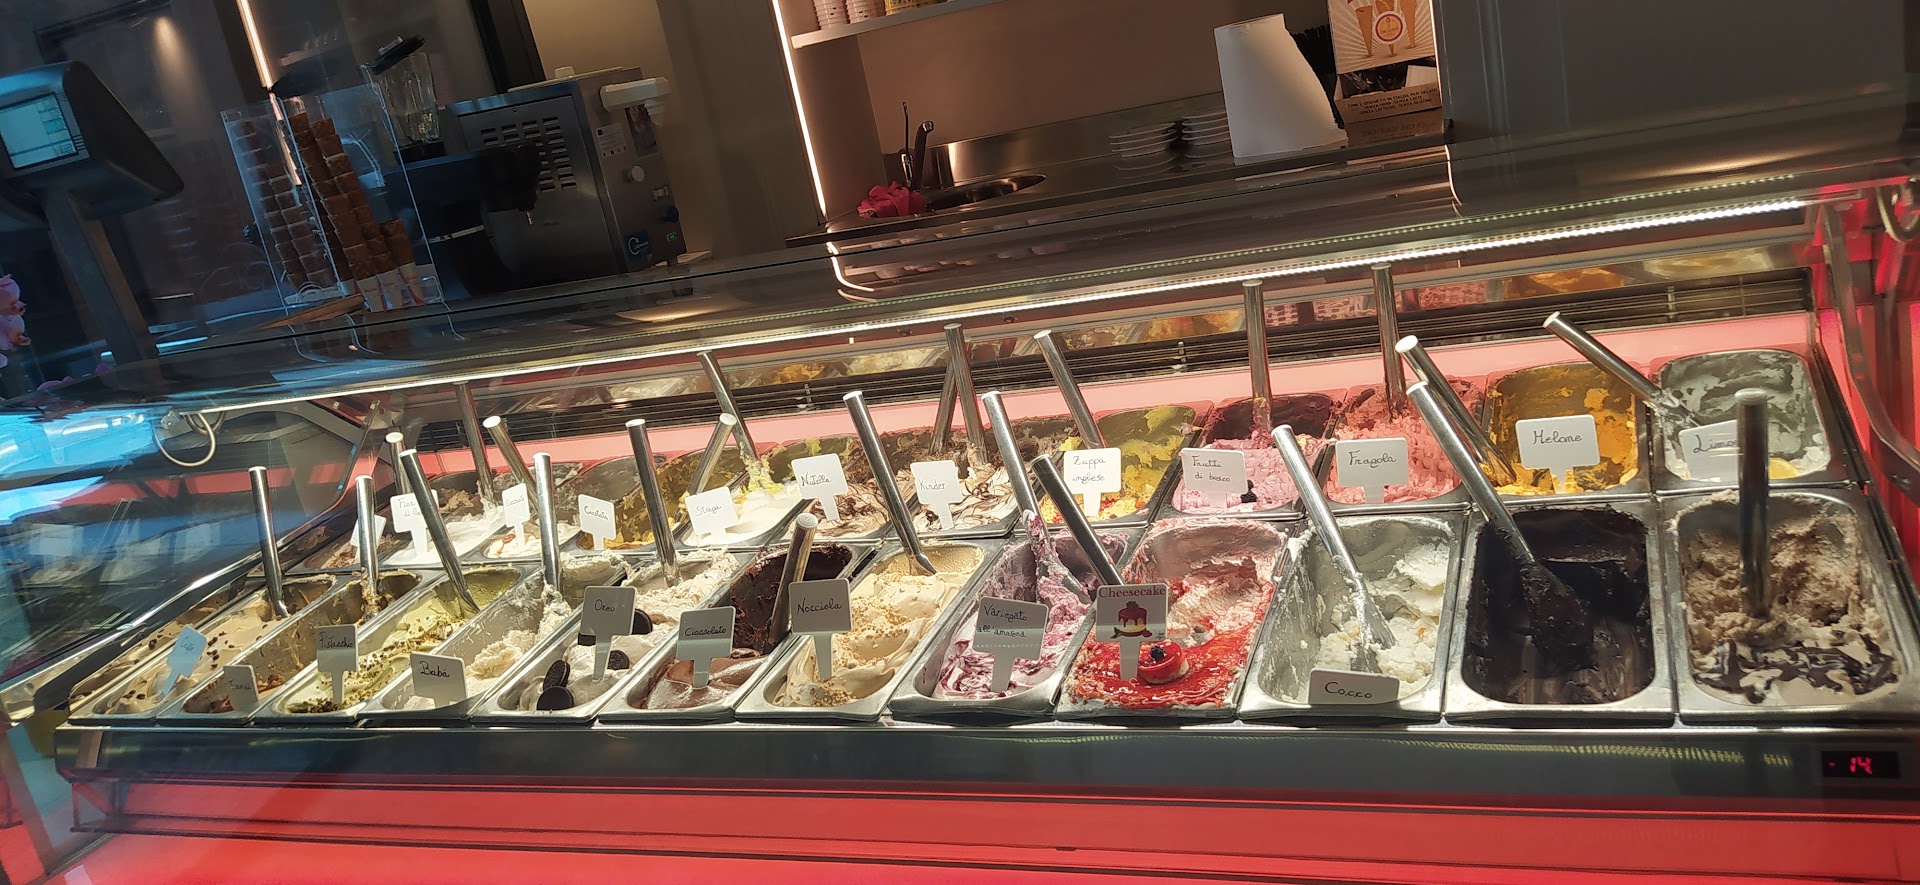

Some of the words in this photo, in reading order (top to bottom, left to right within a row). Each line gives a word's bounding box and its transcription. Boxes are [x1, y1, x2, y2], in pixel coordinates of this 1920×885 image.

[1532, 429, 1583, 445] Melone
[1072, 455, 1107, 469] Zuppa
[1191, 455, 1223, 468] Frutti
[1348, 449, 1397, 469] Fragola
[800, 471, 832, 487] Nutella
[917, 477, 946, 491] Kinder
[1071, 473, 1105, 485] inglese
[1195, 471, 1204, 480] di
[1208, 472, 1231, 483] bosco
[1099, 585, 1166, 598] Cheesecake
[796, 597, 843, 615] Nocciola
[983, 603, 1028, 623] Variegato
[684, 625, 727, 637] Cioccolato
[1324, 681, 1373, 699] Cocco
